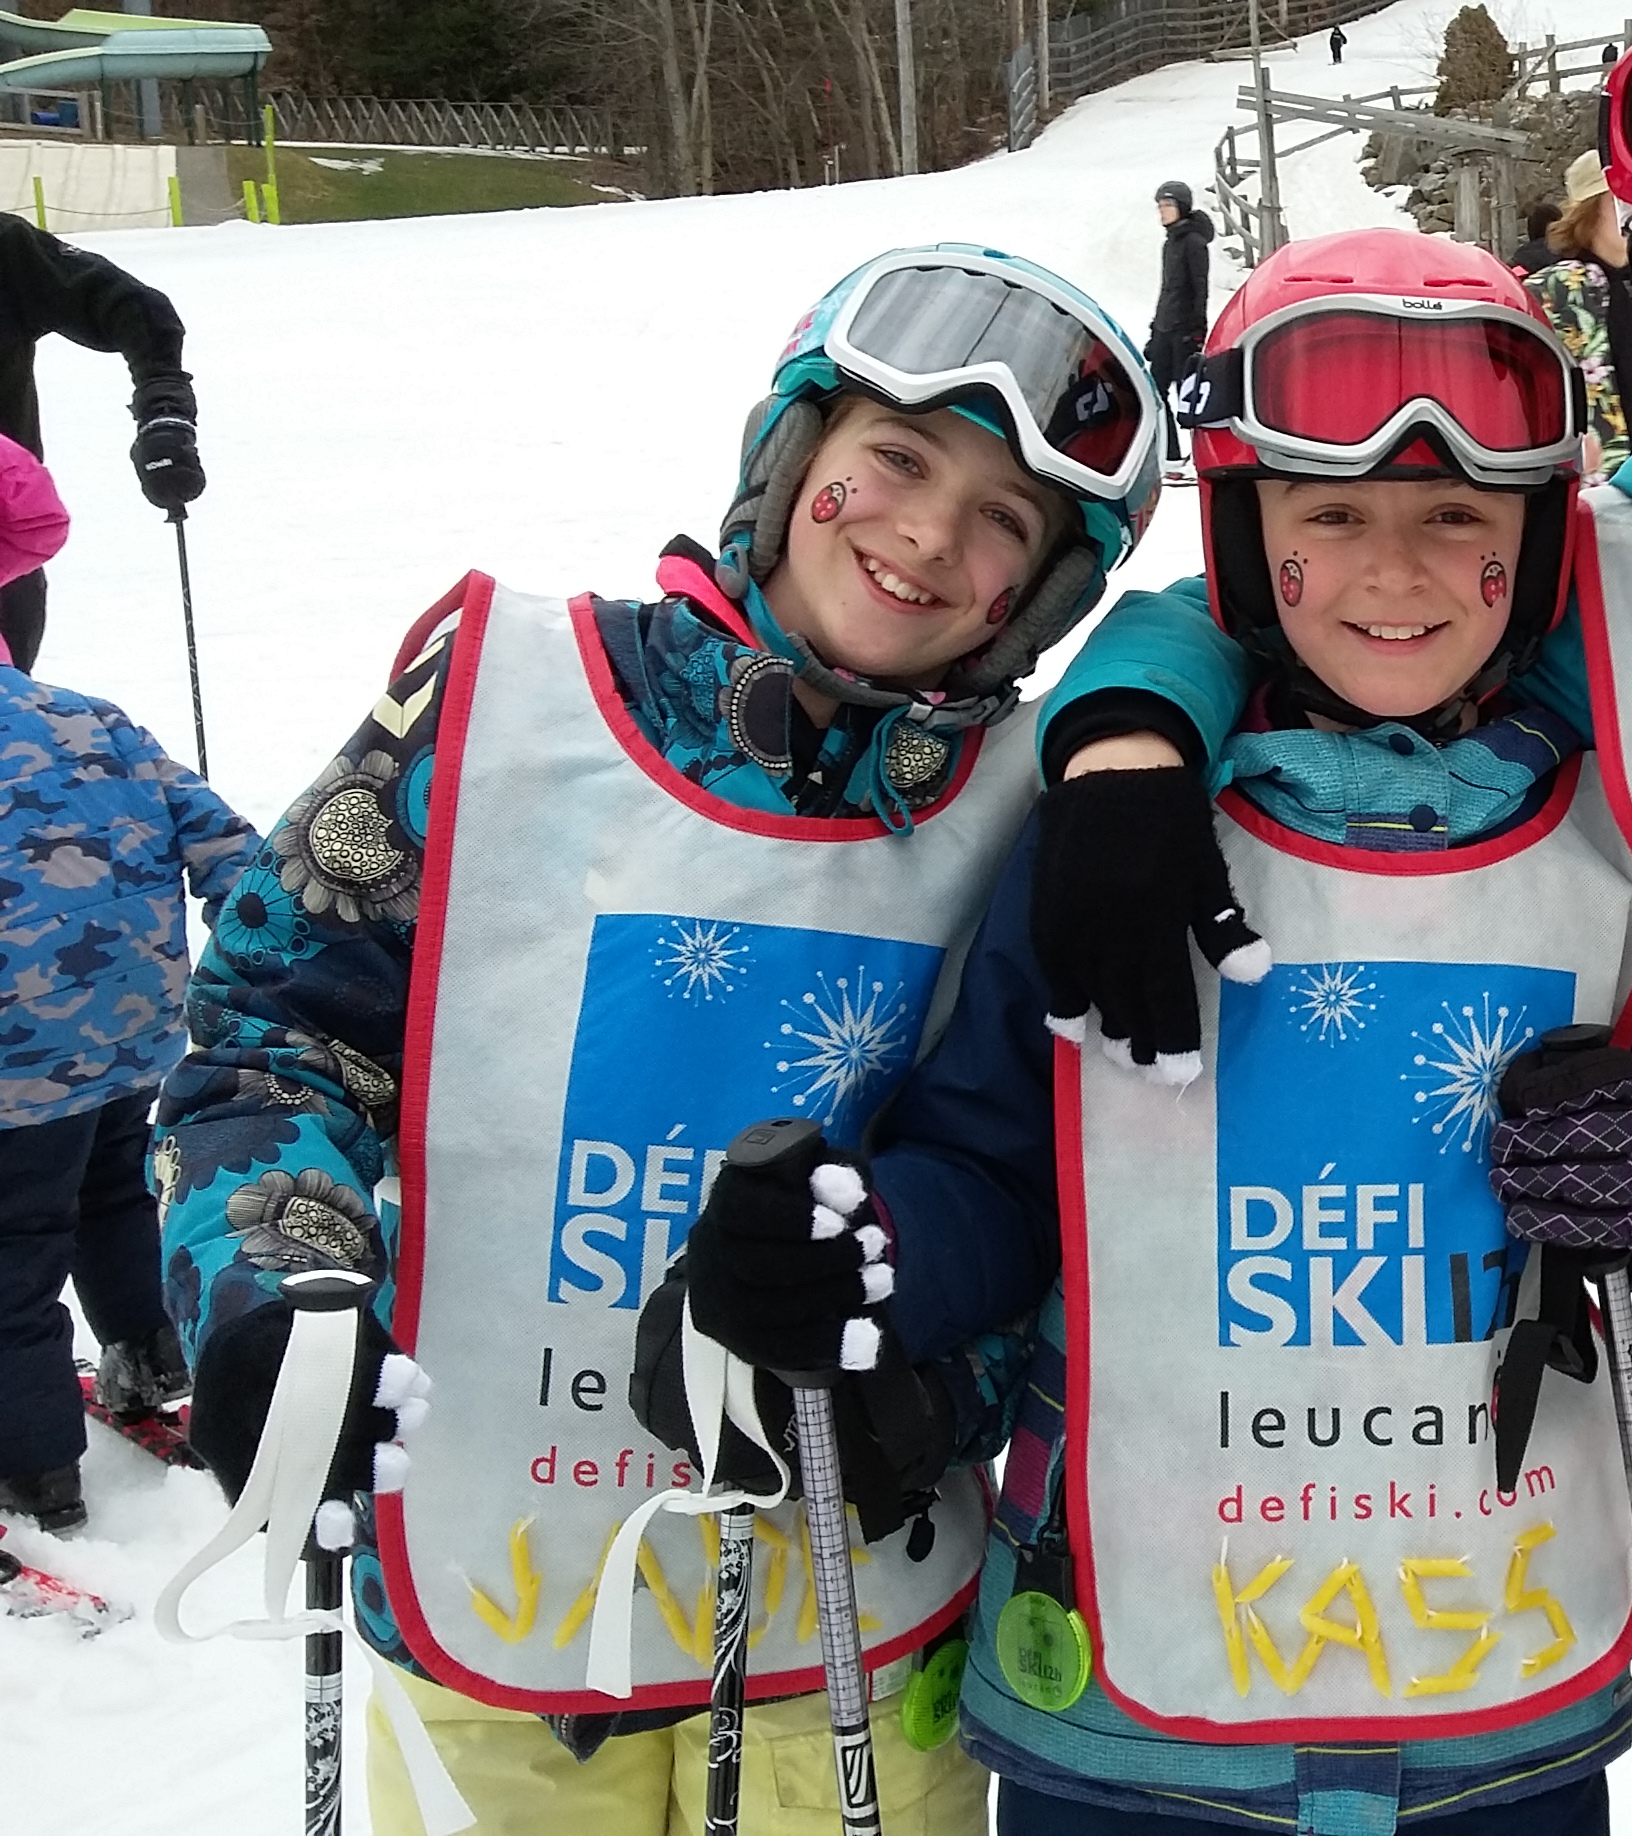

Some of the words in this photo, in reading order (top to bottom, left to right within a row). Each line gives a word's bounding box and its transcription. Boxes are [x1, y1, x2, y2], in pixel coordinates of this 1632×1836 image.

[566, 1123, 728, 1215] DÉ
[1229, 1163, 1425, 1251] DÉFI
[1226, 1254, 1428, 1347] SKI
[1218, 1465, 1556, 1524] defiski.com
[1212, 1521, 1576, 1699] KASS
